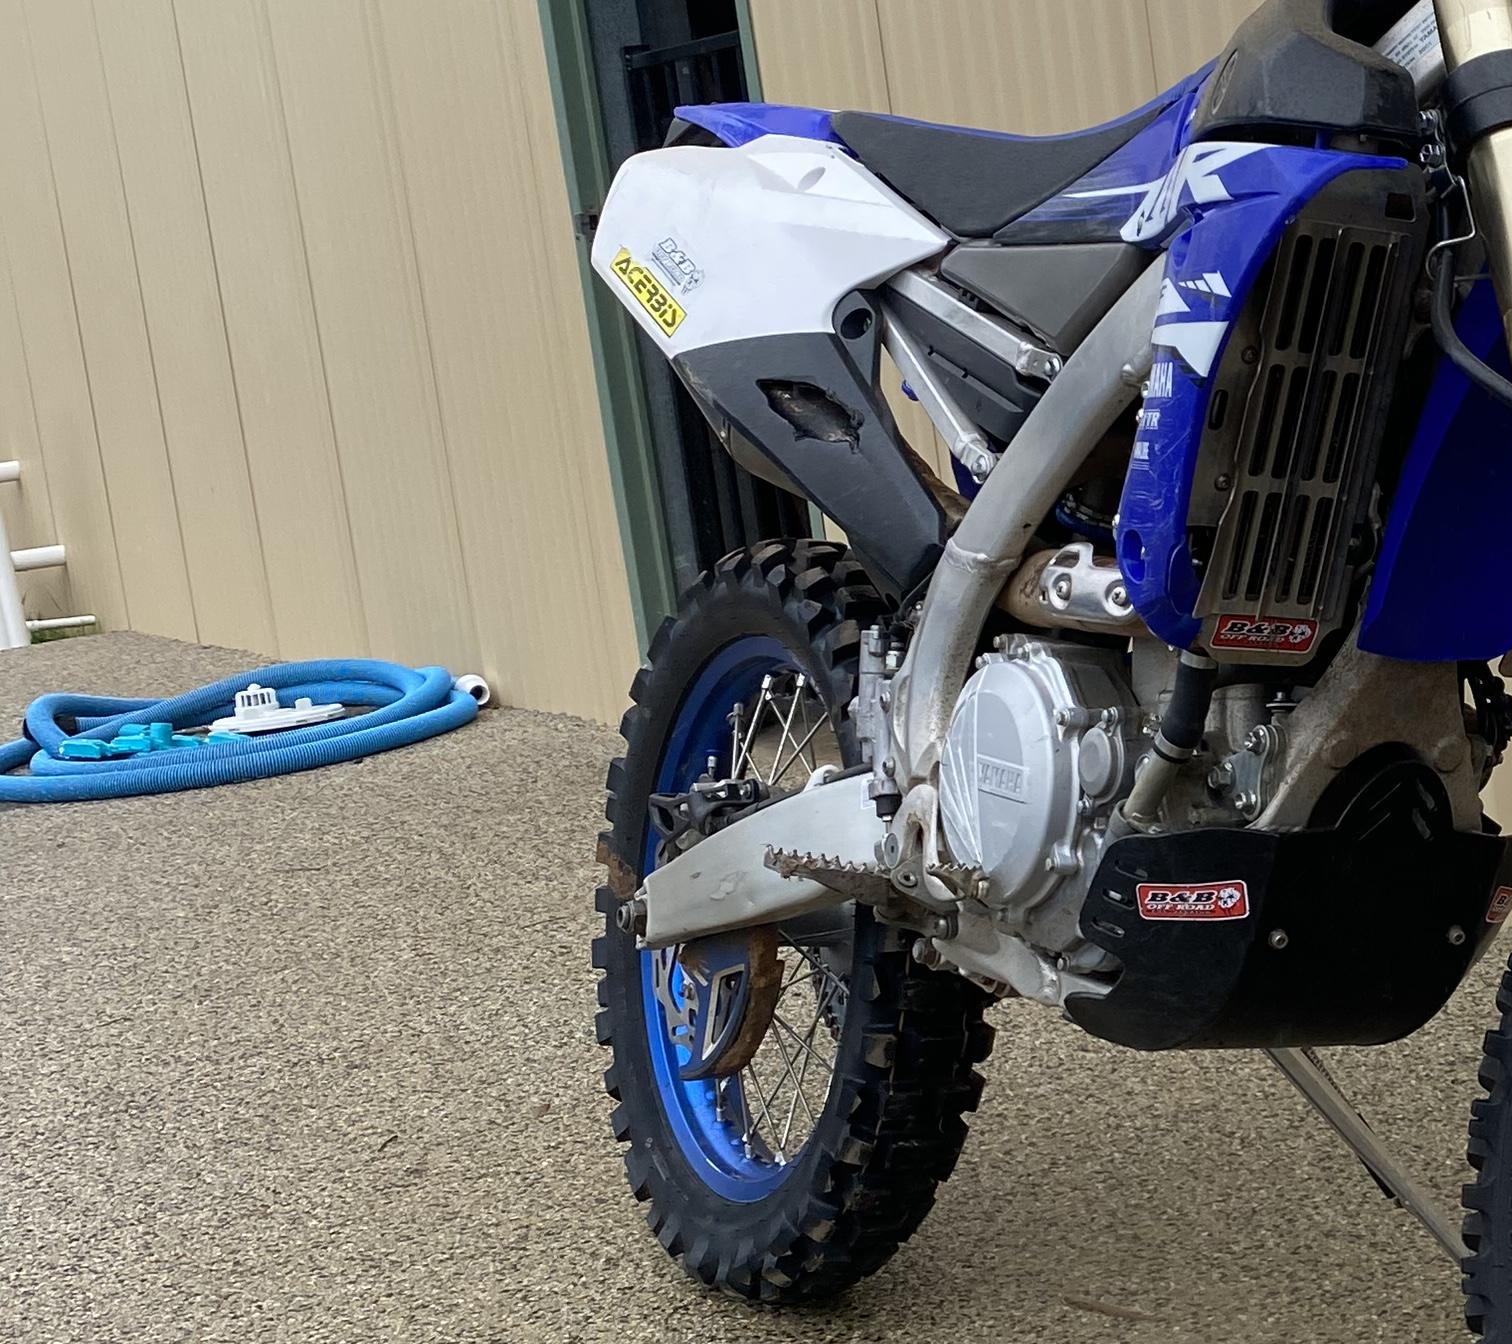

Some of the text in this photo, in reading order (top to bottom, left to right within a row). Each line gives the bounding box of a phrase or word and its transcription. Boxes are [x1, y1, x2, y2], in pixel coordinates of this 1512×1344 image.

[1220, 620, 1293, 637] B&B
[1145, 889, 1217, 905] B&B
[1175, 903, 1216, 911] ROAD
